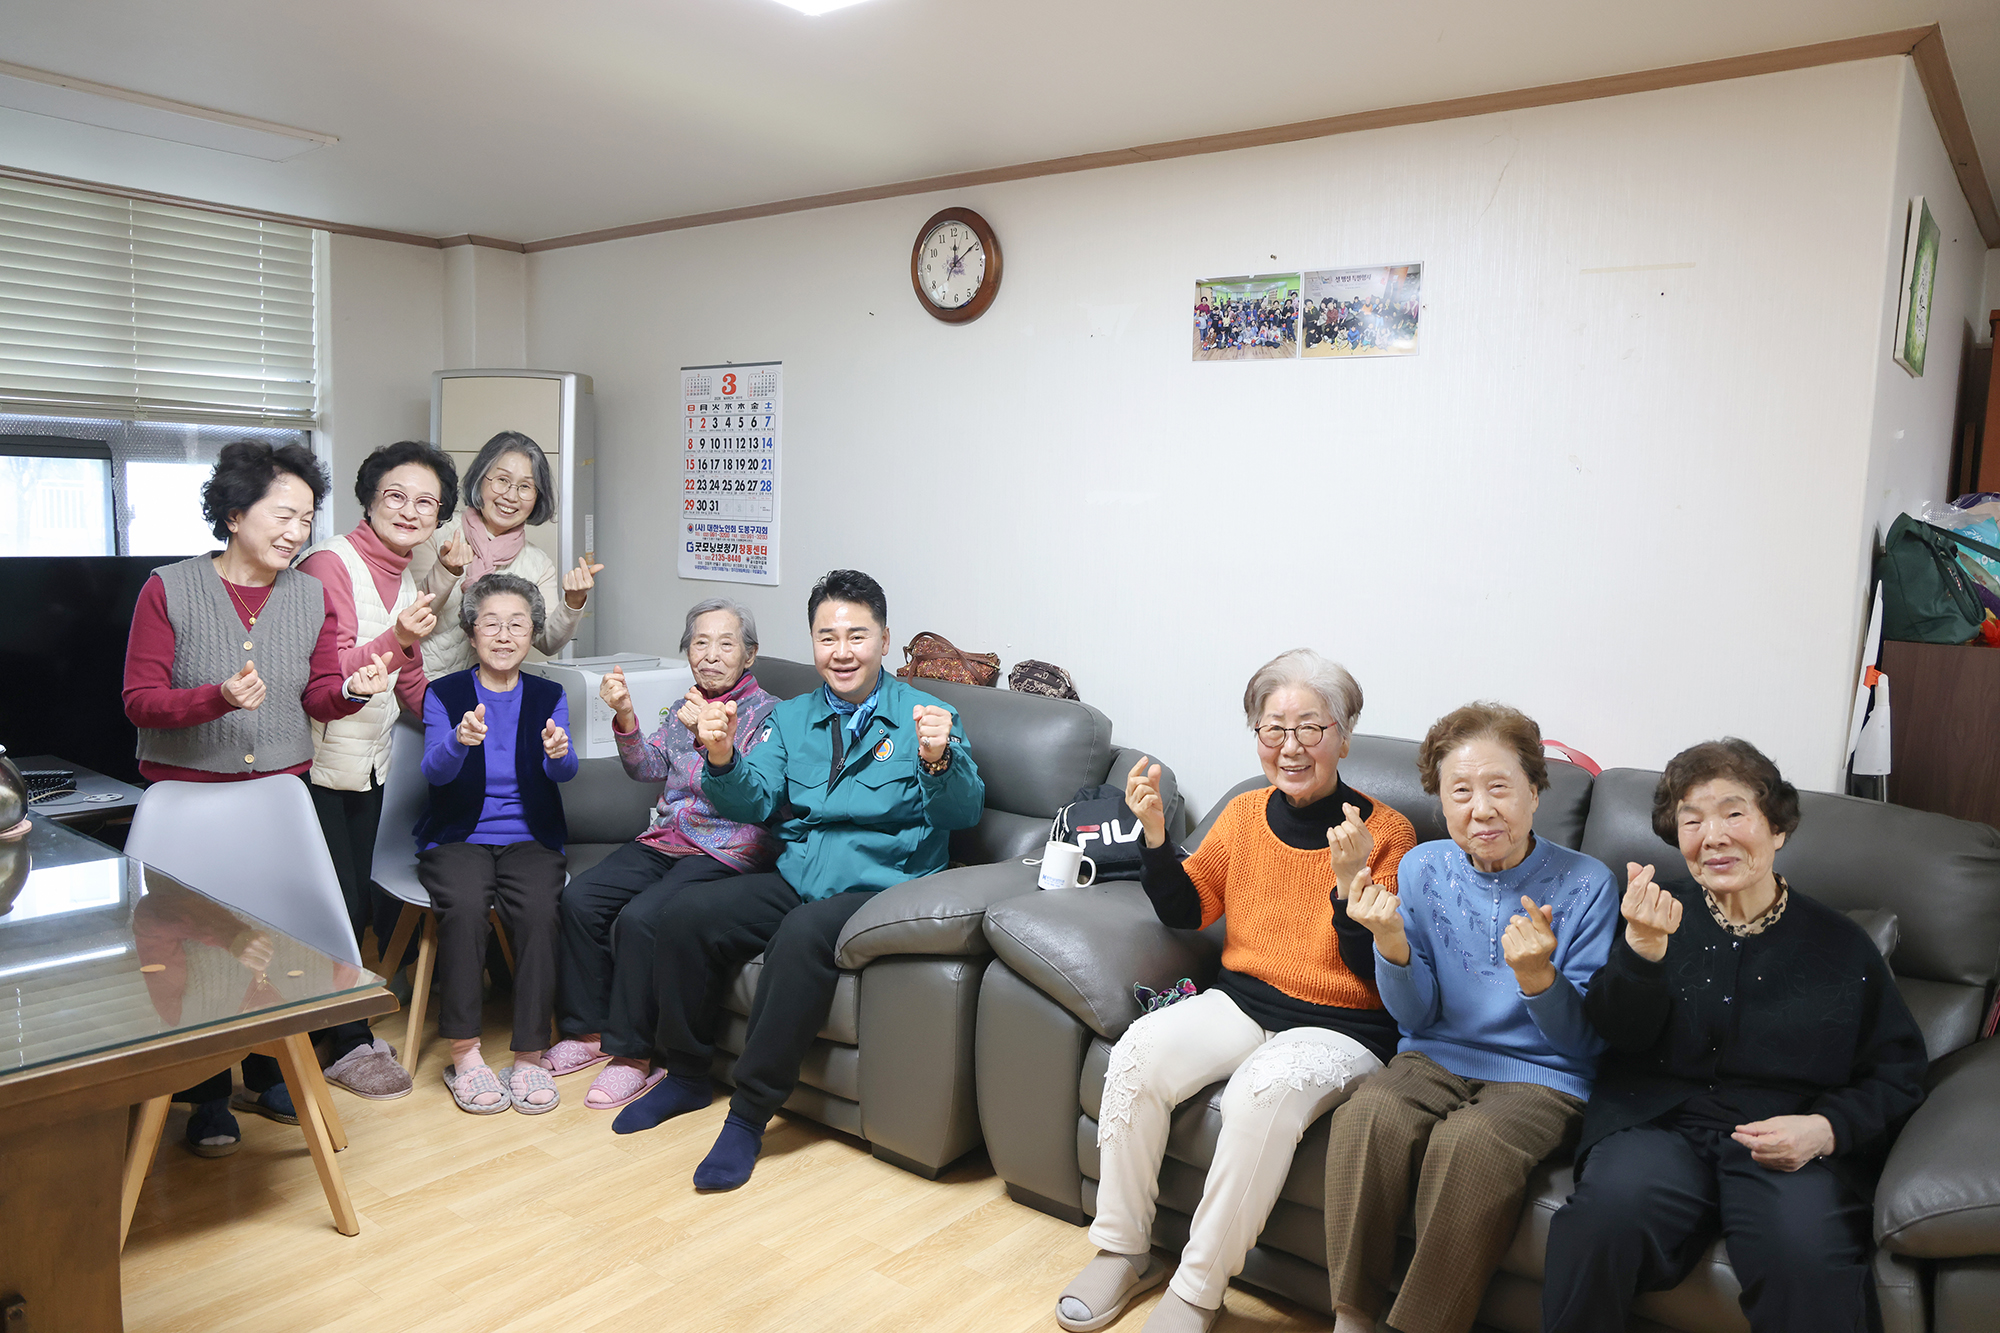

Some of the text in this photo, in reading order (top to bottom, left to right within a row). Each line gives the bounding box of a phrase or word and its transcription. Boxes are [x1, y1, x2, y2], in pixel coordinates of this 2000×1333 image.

[950, 227, 958, 237] 12
[965, 231, 969, 240] 1
[939, 234, 946, 244] 11
[975, 241, 980, 251] 2
[930, 248, 938, 258] 10
[927, 264, 932, 272] 9
[976, 275, 980, 284] 4
[932, 281, 937, 290] 8
[942, 291, 946, 300] 7
[954, 294, 959, 302] 6
[967, 288, 972, 298] 5
[722, 373, 737, 395] 3
[689, 416, 771, 429] 1 2 3 4 5 6 7
[688, 437, 773, 449] 8 9 10 11 12 13 14
[686, 459, 772, 470] 15 16 17 18 19 20 21
[685, 479, 772, 491] 22 23 24 25 26 27 28
[684, 500, 719, 511] 29 30 31
[707, 524, 736, 533] 대한노인회
[738, 526, 768, 534] 도봉구지회
